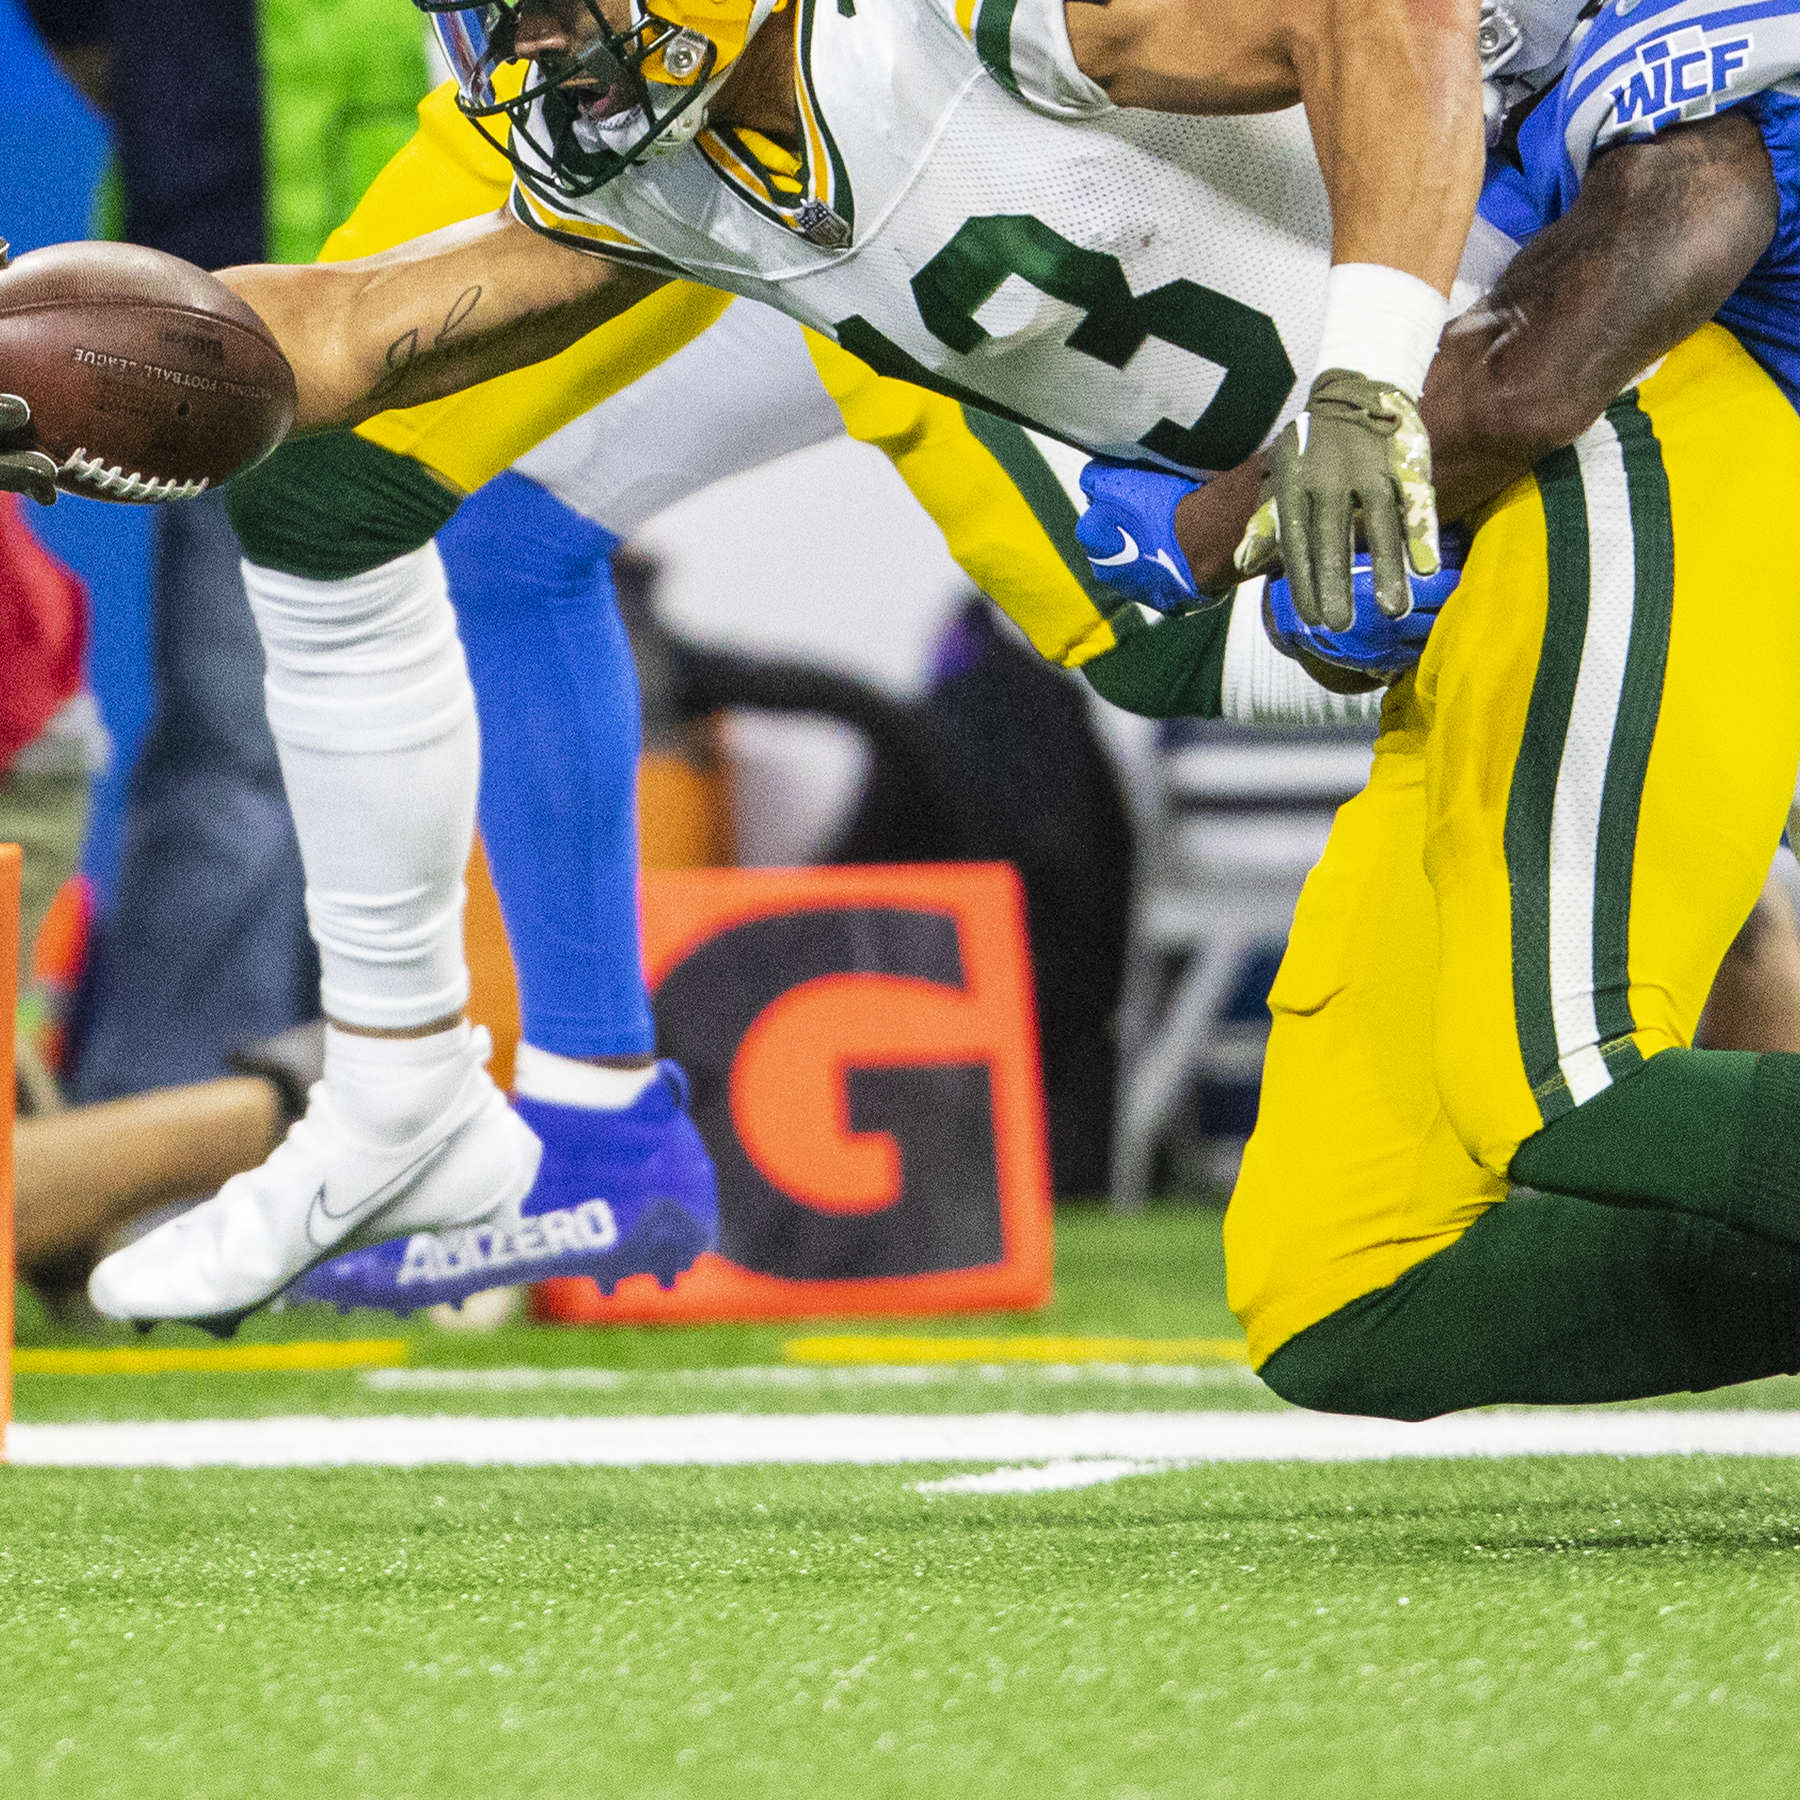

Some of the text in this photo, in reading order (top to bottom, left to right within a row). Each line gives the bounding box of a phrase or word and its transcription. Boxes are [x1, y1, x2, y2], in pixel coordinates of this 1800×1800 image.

[1608, 35, 1753, 128] WCF
[143, 364, 218, 391] FOOTBALL
[834, 214, 1297, 476] 13
[653, 906, 1004, 1283] G
